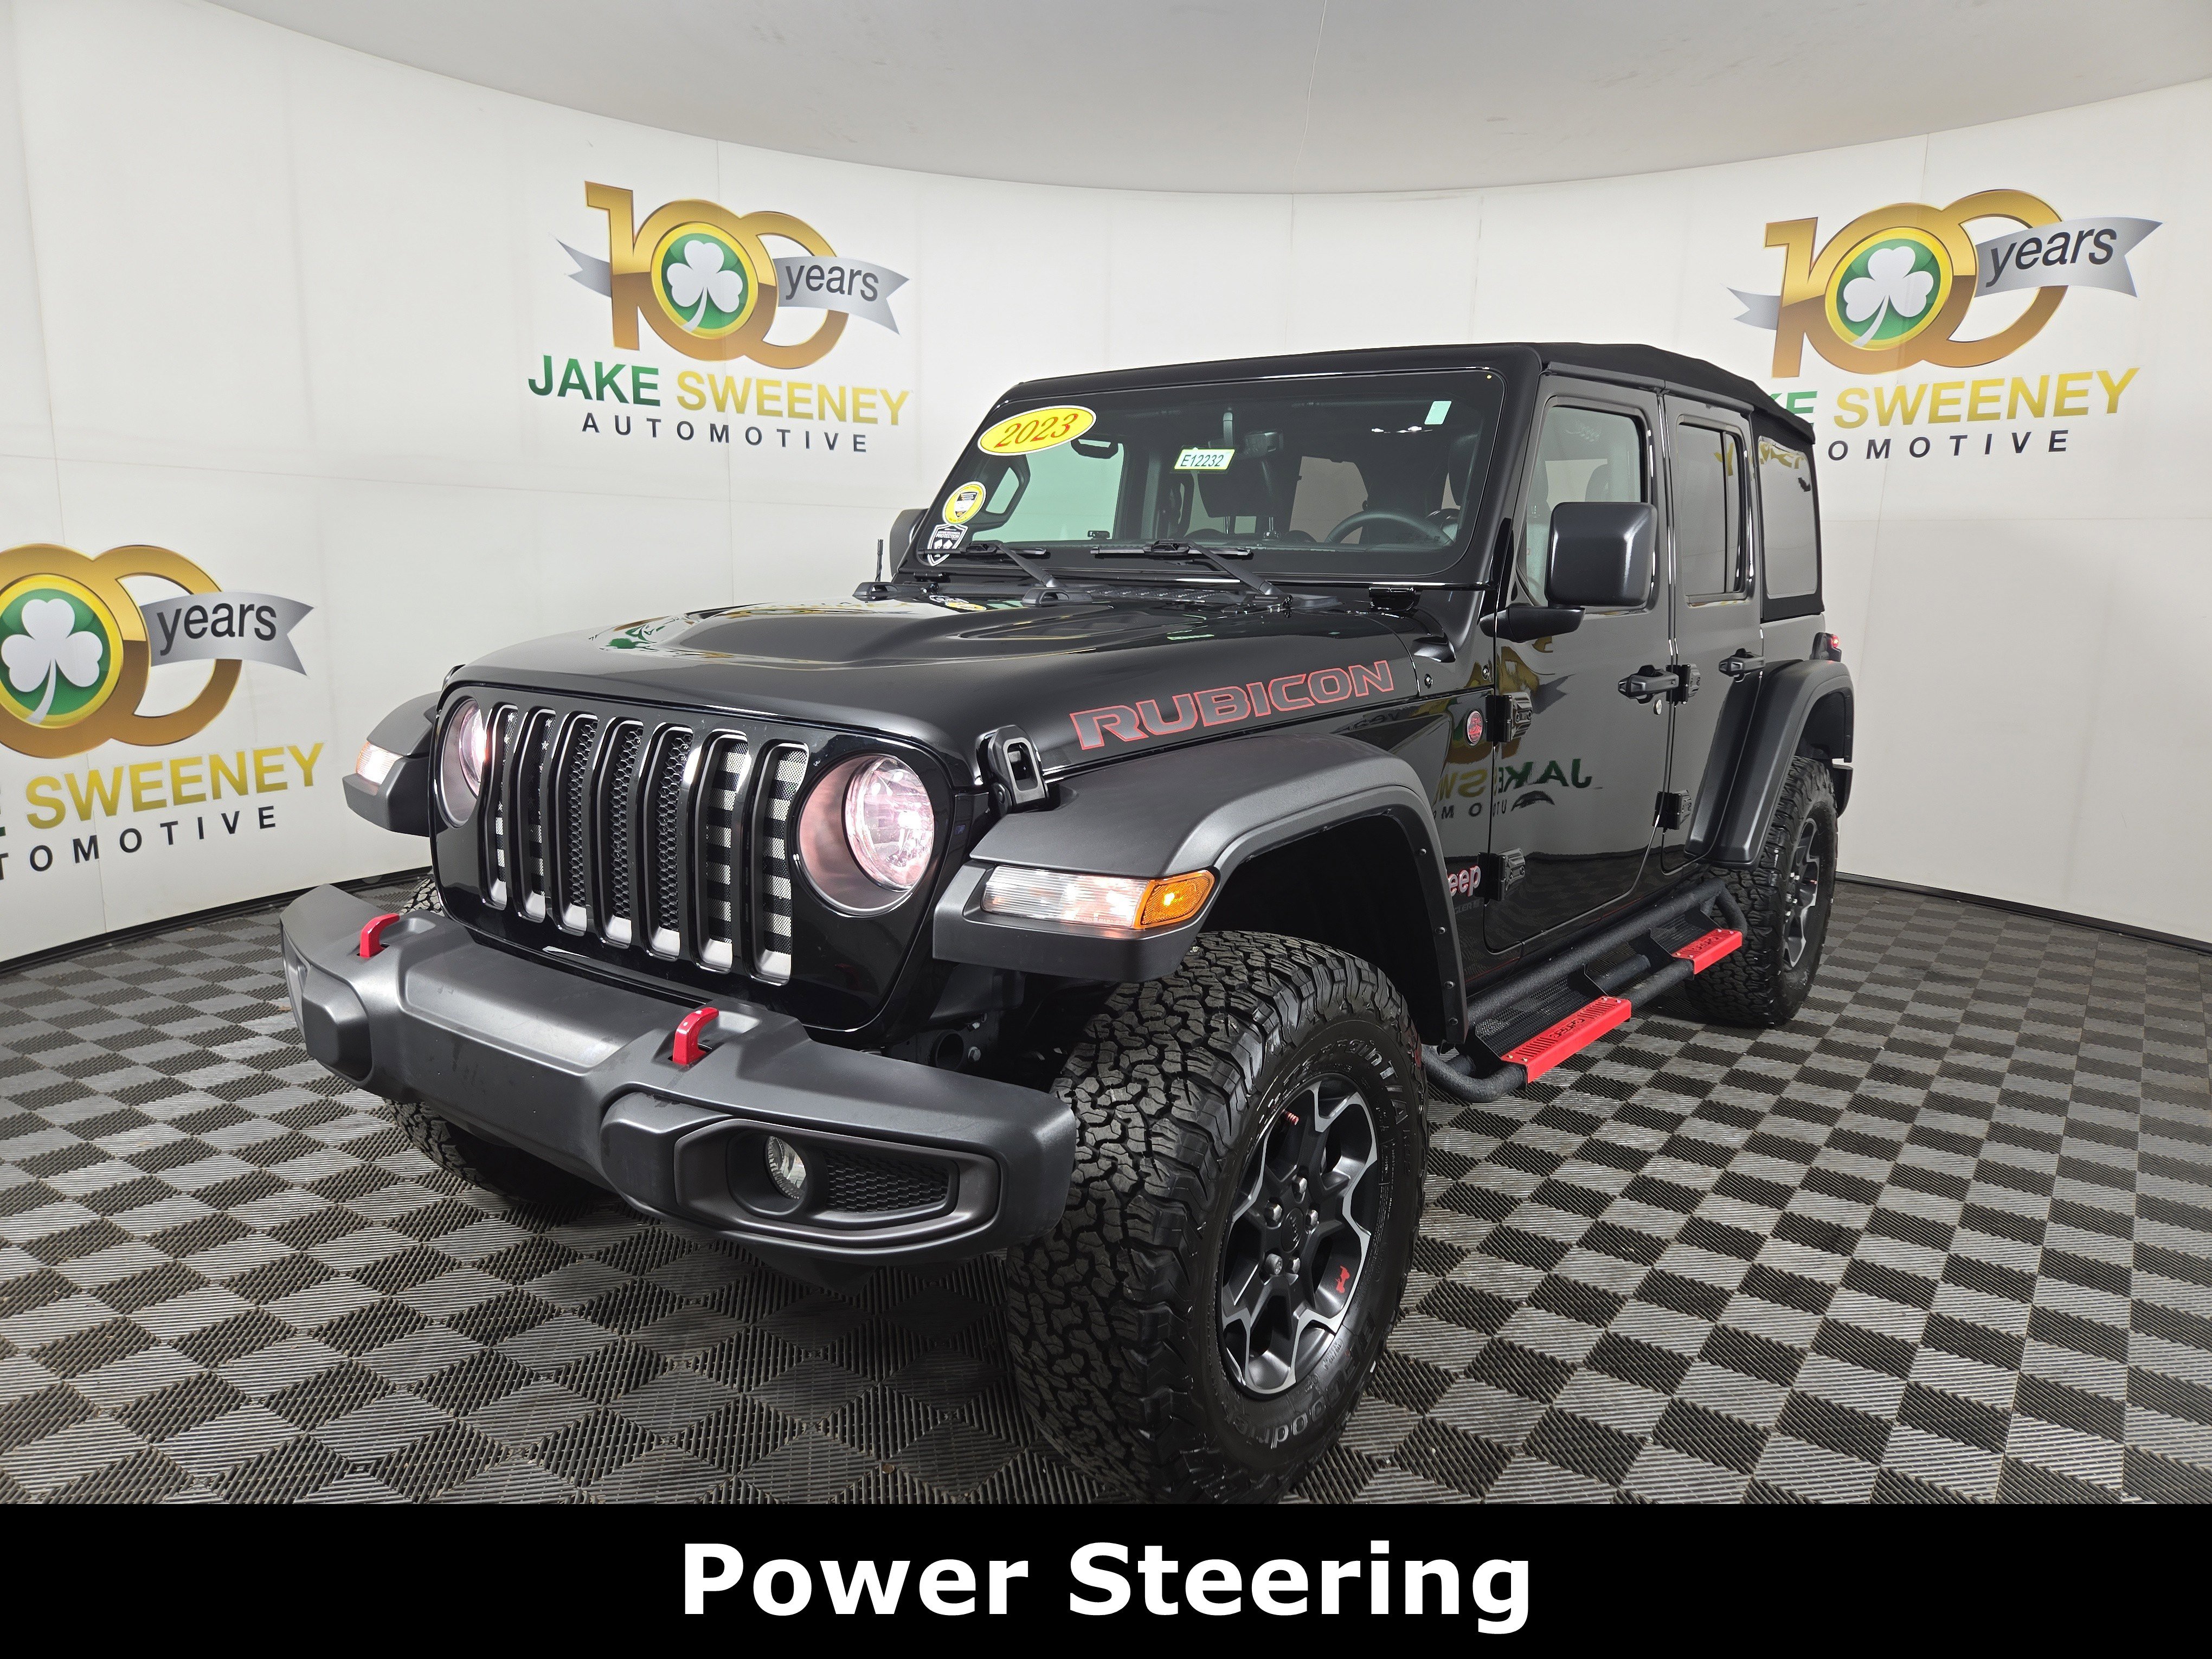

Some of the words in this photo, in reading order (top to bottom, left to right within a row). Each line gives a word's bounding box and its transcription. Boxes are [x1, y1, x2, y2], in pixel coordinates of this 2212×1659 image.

[584, 181, 850, 370] 100
[785, 264, 879, 303] years
[1763, 189, 2069, 379] 100
[1985, 226, 2117, 288] years
[528, 354, 661, 408] JAKE
[677, 371, 910, 427] SWEENEY
[1834, 367, 2140, 429] SWEENEY
[582, 412, 867, 453] AUTOMOTIVE
[994, 413, 1079, 448] 2023
[1828, 429, 2069, 461] OMOTIVE
[1180, 454, 1224, 467] E12232
[157, 602, 277, 655] years
[1069, 660, 1394, 750] RUBICON
[25, 742, 324, 829] SWEENEY
[1448, 865, 1482, 897] eep
